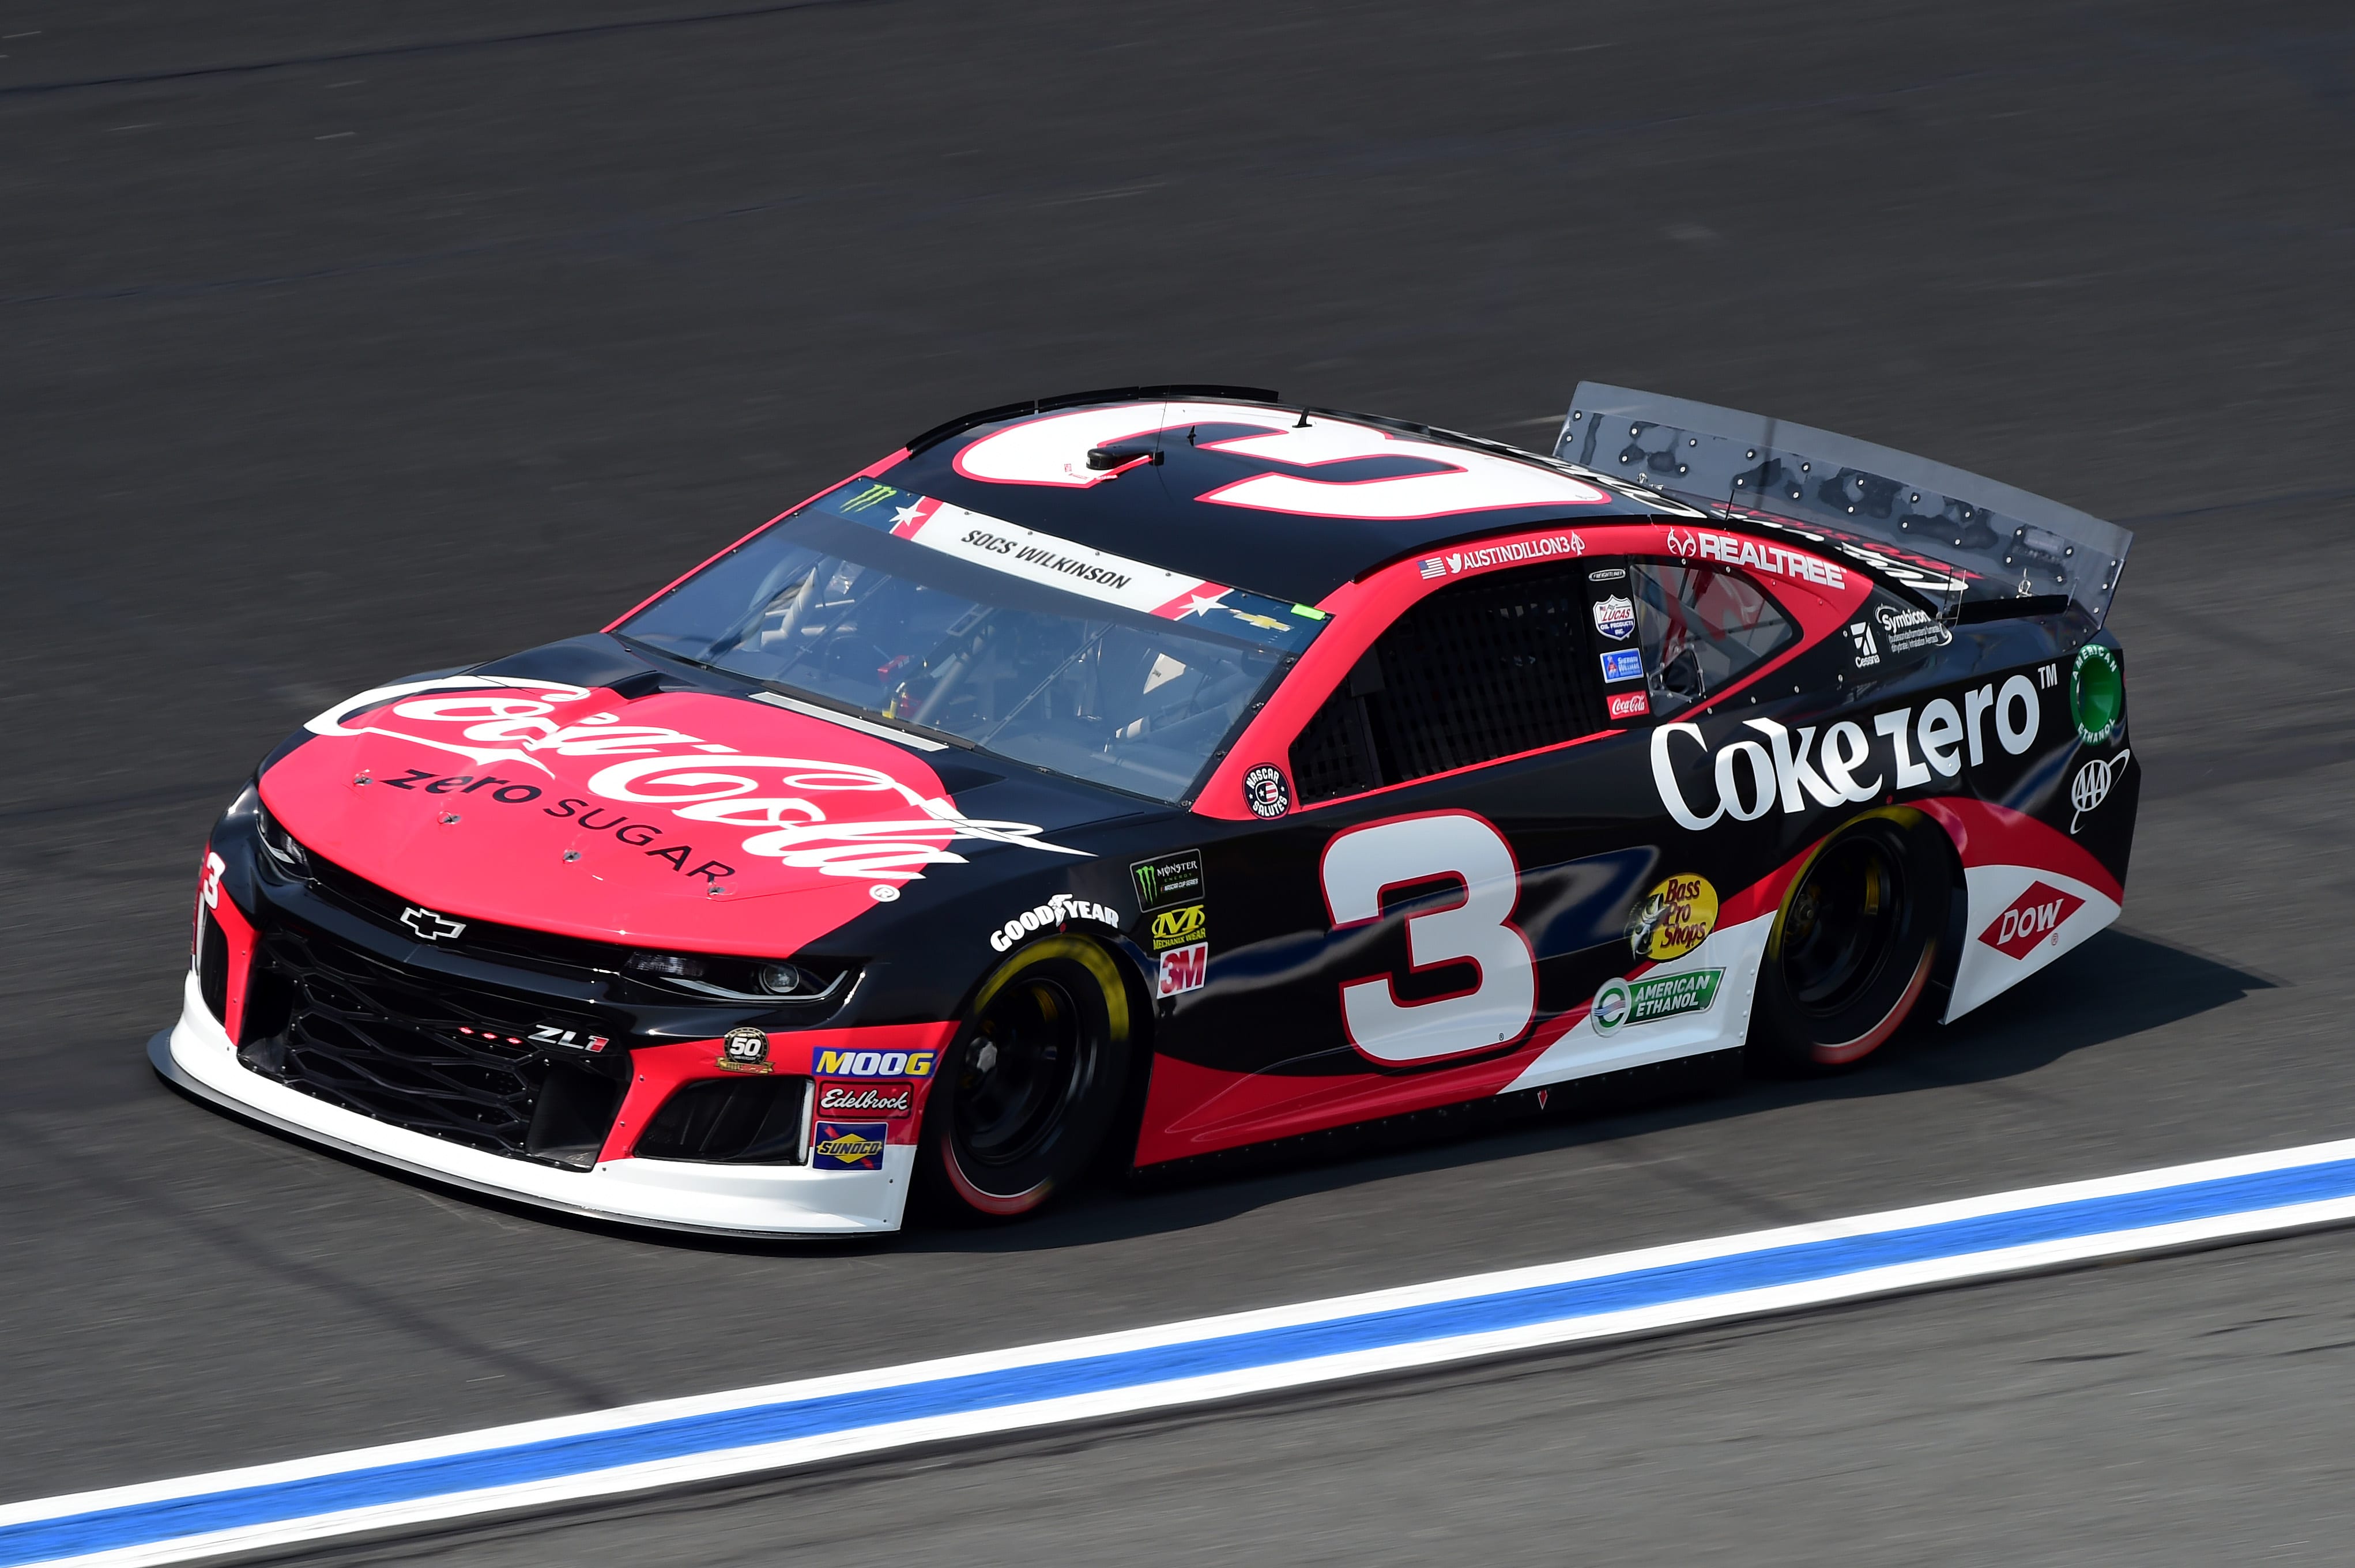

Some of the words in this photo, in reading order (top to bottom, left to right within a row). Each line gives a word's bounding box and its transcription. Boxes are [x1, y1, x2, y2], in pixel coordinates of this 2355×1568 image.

[954, 401, 1612, 521] 3
[961, 530, 1018, 554] SOCS
[1015, 546, 1132, 589] WILKINSON
[1463, 536, 1570, 570] AUSTINDILLON3
[1698, 532, 1845, 590] REALTREE
[1602, 608, 1631, 621] LUCAS
[1855, 654, 1881, 668] Cessna
[2073, 644, 2117, 680] AMERICAN
[2077, 718, 2115, 744] ETHANOL
[1651, 717, 1883, 831] Coke
[1874, 674, 2040, 790] zero
[303, 675, 1099, 880] Coca-Cola
[1246, 768, 1279, 790] NASCAR
[2075, 762, 2108, 809] AAA
[1253, 795, 1287, 816] SALUTES
[379, 768, 542, 804] zero
[542, 798, 736, 883] SUGAR
[202, 851, 226, 909] 3
[1156, 861, 1198, 877] MONSTER
[1664, 879, 1701, 903] Bass
[990, 898, 1120, 952] GOODYEAR
[1663, 902, 1691, 925] Pro
[1996, 898, 2064, 945] DOW
[1153, 936, 1185, 951] MECHANIX
[1185, 927, 1207, 942] WEAR
[1320, 808, 1539, 1067] 3
[1660, 921, 1706, 949] Shops
[1160, 946, 1205, 994] 3M
[1634, 975, 1710, 1002] AMERICAN
[1636, 993, 1699, 1017] ETHANOL
[527, 1024, 609, 1053] ZL1
[729, 1036, 762, 1056] 50
[816, 1051, 934, 1076] MOOG
[820, 1088, 909, 1110] Edelbrock
[819, 1142, 882, 1154] SUNOCO
